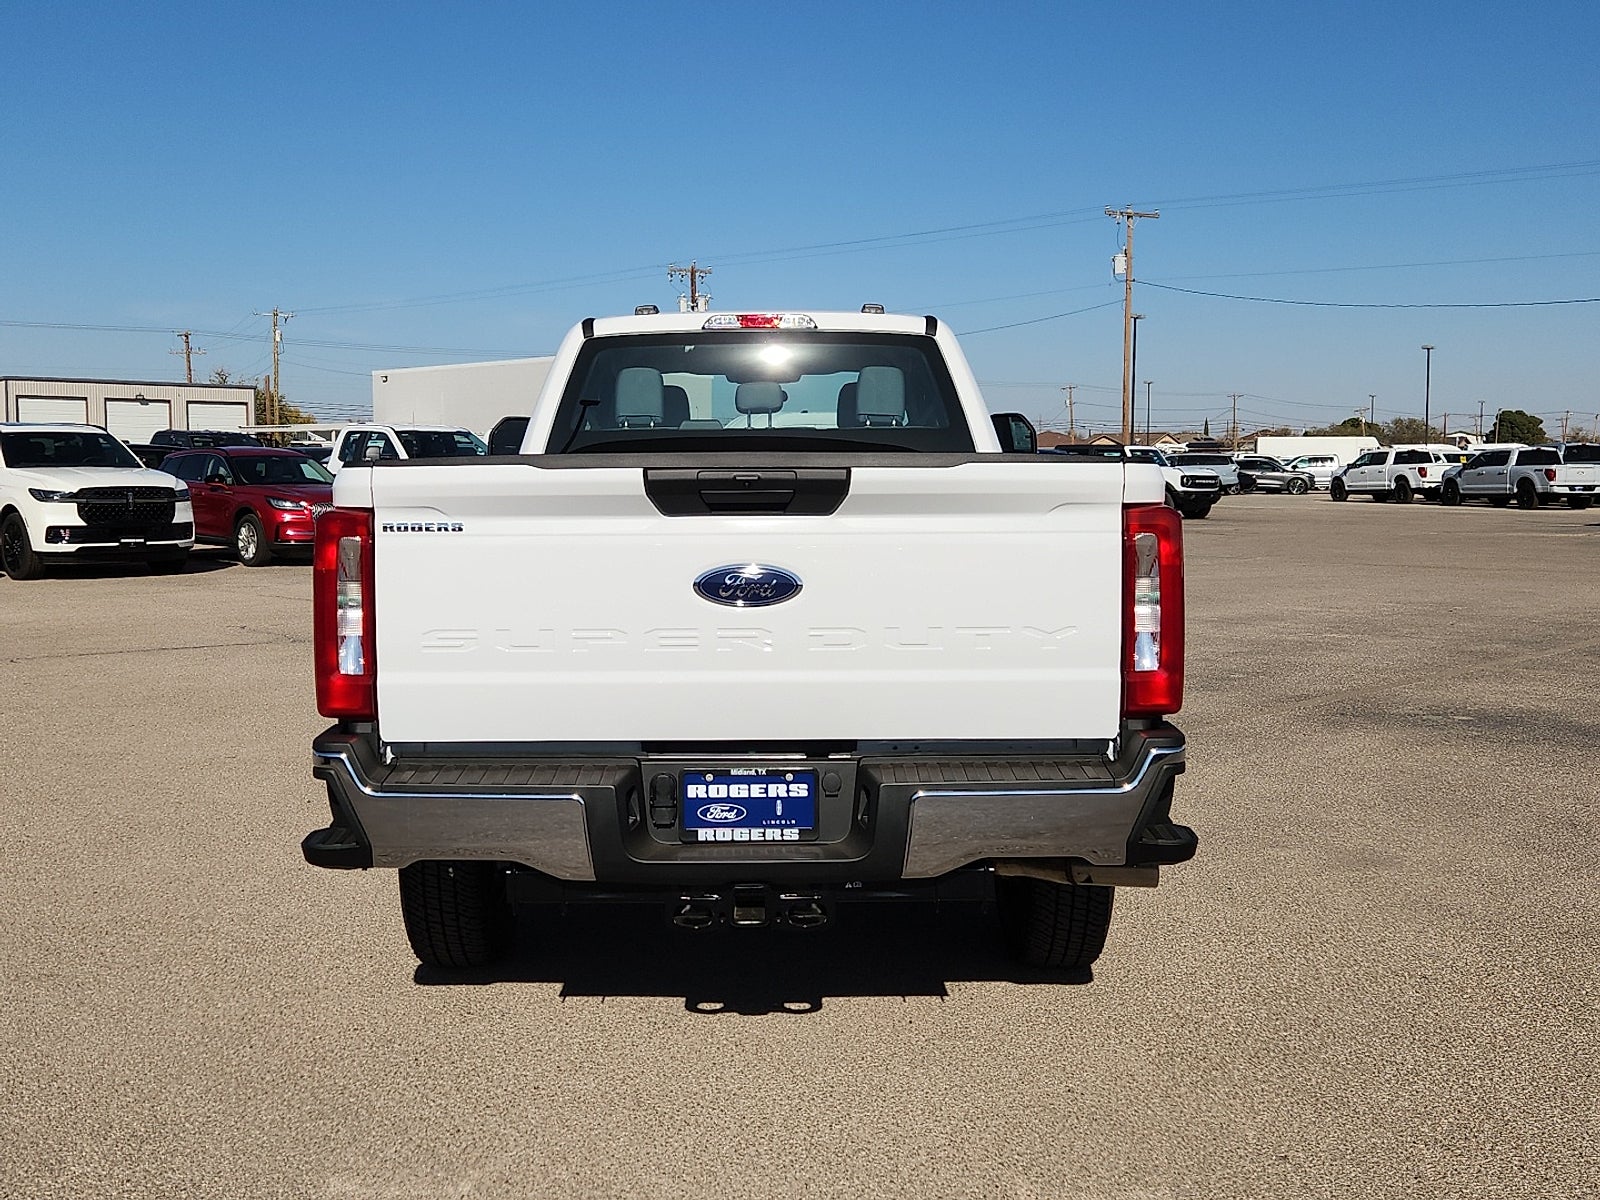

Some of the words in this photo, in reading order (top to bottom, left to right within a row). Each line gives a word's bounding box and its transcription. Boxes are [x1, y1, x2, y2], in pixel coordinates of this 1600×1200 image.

[382, 522, 464, 533] ROGERS
[718, 573, 777, 598] Ford
[420, 627, 776, 654] SUPER
[807, 625, 1079, 653] DUTY
[758, 768, 767, 776] TX
[687, 783, 809, 799] ROGERS
[706, 805, 738, 820] Ford
[697, 828, 800, 842] ROGERS
